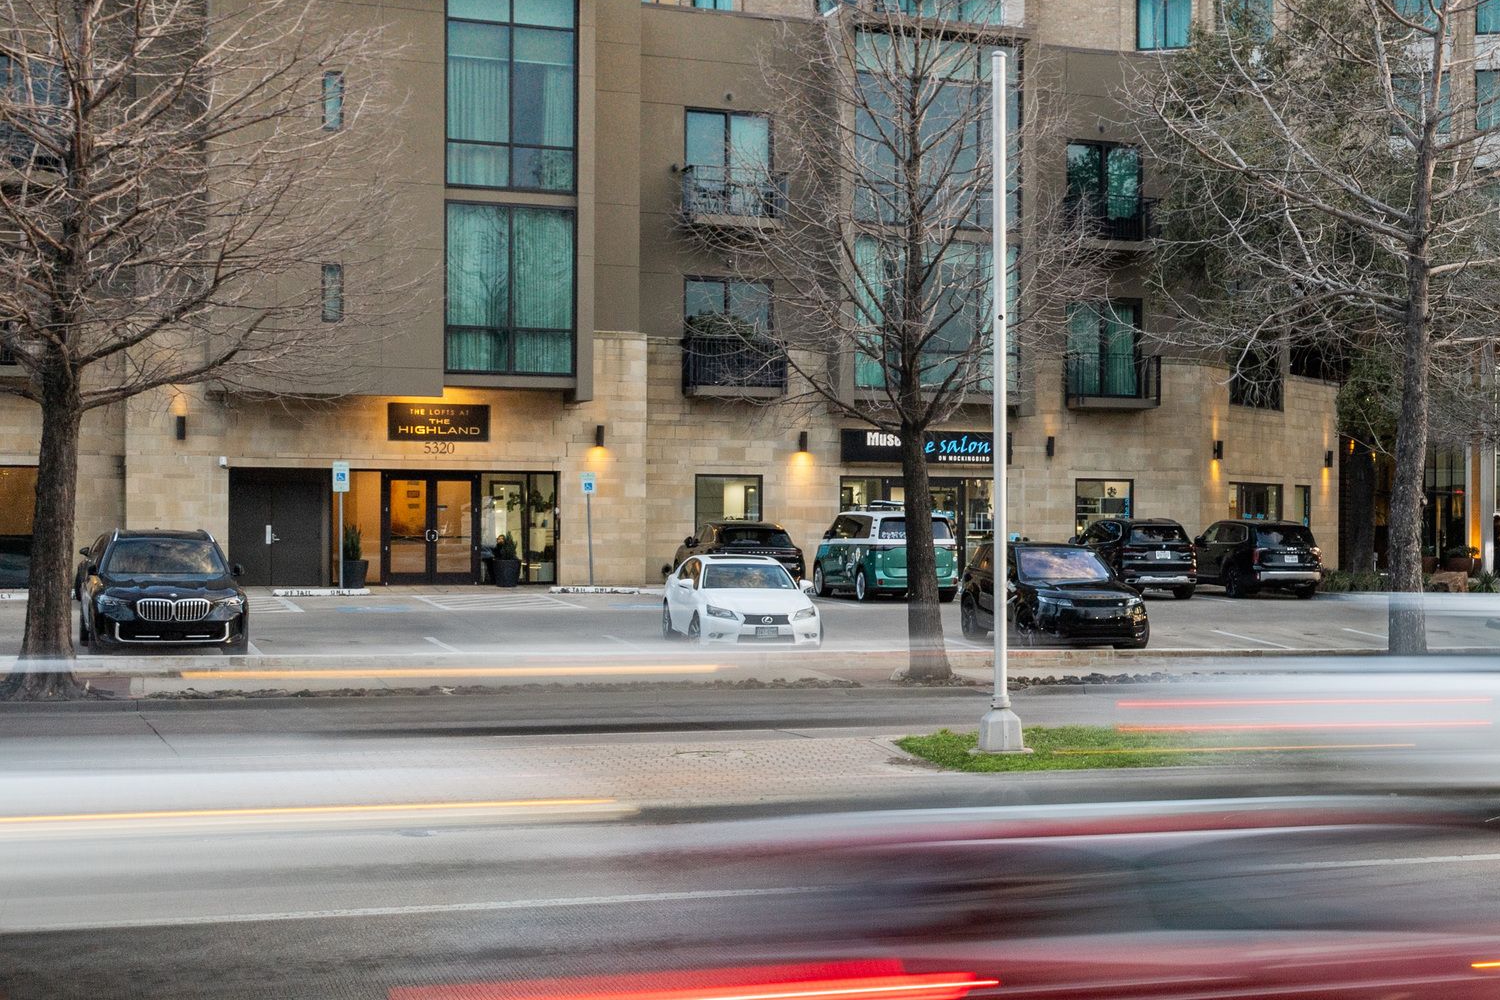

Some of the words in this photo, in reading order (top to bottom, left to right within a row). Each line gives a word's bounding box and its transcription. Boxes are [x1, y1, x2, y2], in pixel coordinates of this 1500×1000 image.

[410, 408, 425, 416] THE
[429, 408, 455, 416] LOFTS
[398, 425, 481, 436] HIGHLAND
[424, 441, 455, 454] 5320
[939, 435, 991, 454] salon
